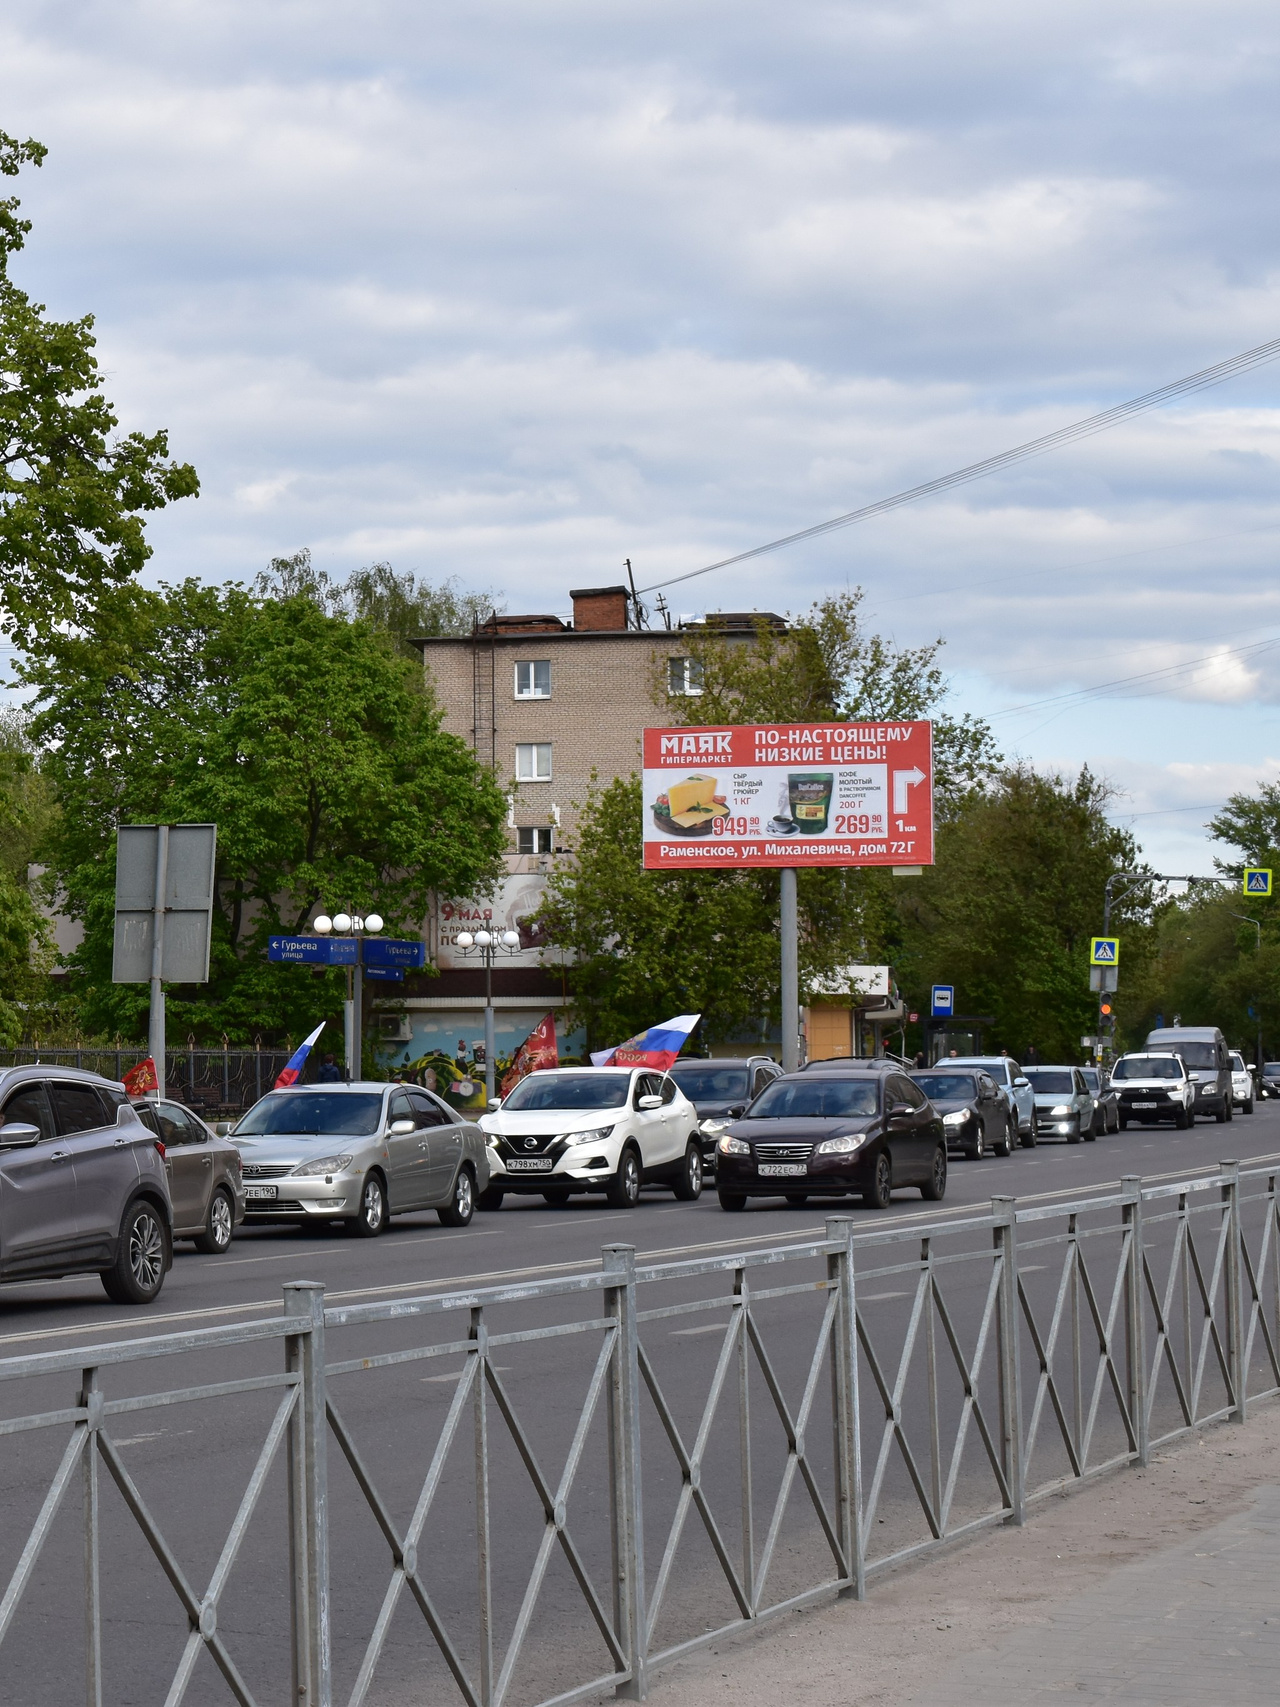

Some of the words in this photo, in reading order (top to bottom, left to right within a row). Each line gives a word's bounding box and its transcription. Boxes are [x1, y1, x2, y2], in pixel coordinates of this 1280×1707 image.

[754, 726, 913, 745] ПО-НАСТОЯЩЕМУ
[660, 735, 733, 754] МАЯК
[660, 755, 733, 764] ГИПЕРМАРКЕТ
[754, 746, 824, 762] НИЗКИЕ
[830, 745, 887, 762] ЦЕНЫ!
[839, 801, 856, 809] 200
[712, 816, 748, 837] 949
[749, 817, 760, 825] 90
[835, 814, 870, 834] 269
[871, 815, 882, 823] 90
[660, 845, 738, 858] Раменское,
[741, 846, 761, 858] ул.
[765, 843, 855, 856] Михалевича,
[858, 844, 887, 856] дом
[441, 902, 454, 921] 9
[458, 908, 493, 920] МАЯ
[281, 939, 318, 951] Гурьева
[281, 951, 304, 960] улица
